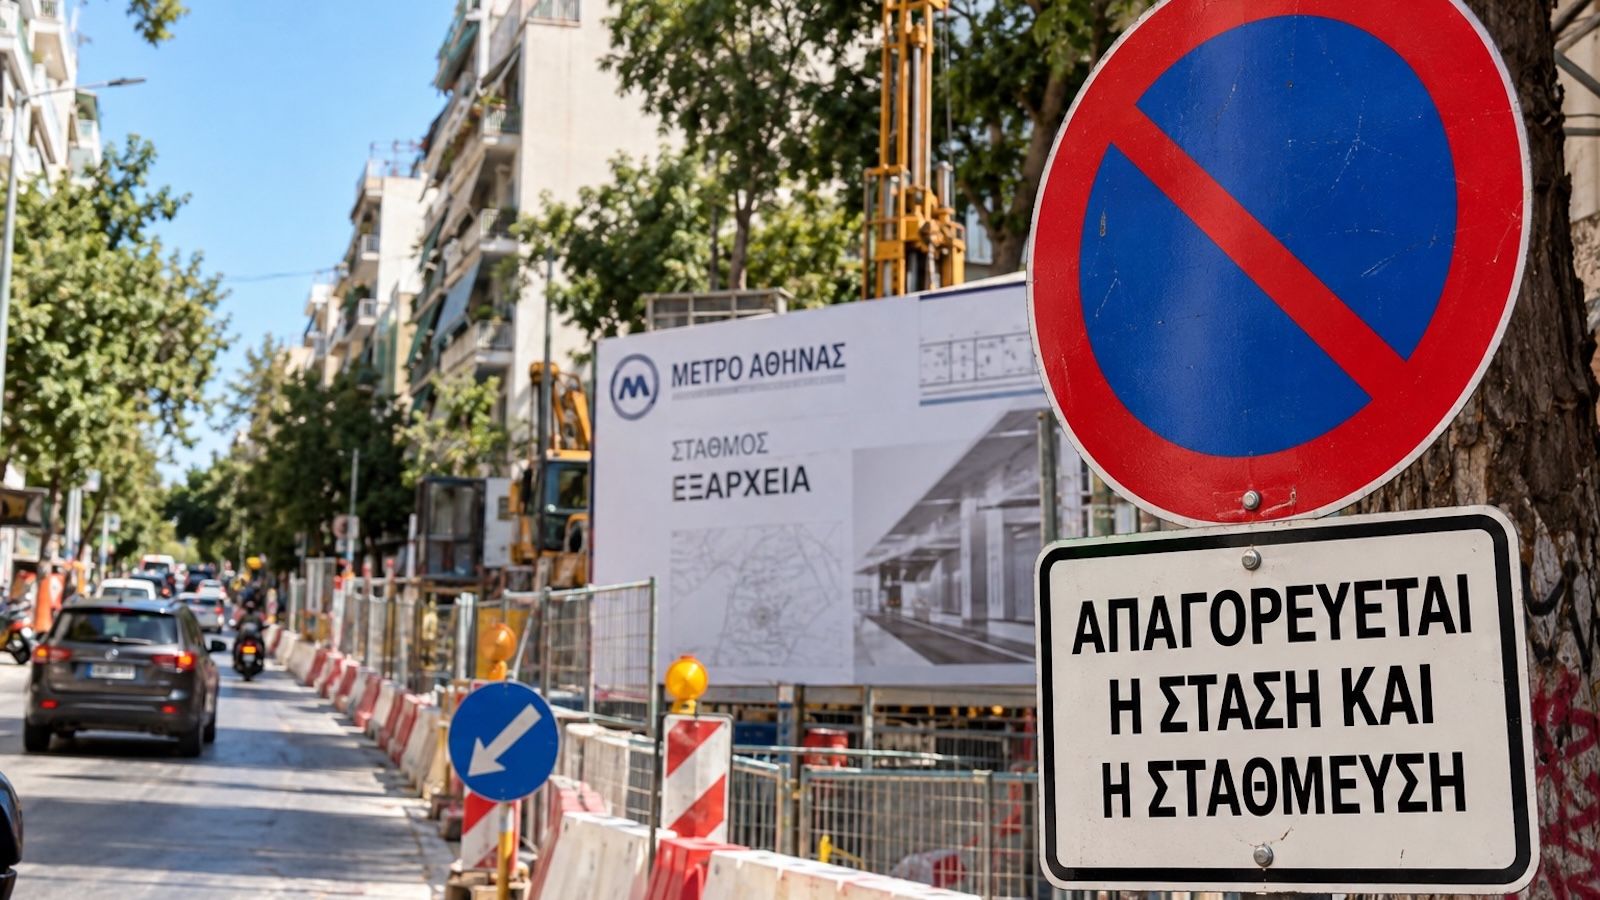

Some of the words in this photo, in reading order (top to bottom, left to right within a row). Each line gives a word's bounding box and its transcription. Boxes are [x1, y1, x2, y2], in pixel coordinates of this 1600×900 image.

[671, 355, 743, 387] ΜΕΤΡΟ
[749, 342, 846, 379] ΑΘΗΝΑΣ
[671, 431, 769, 463] ΣΤΑΘΜΟΣ
[672, 465, 811, 502] ΕΞΑΡΧΕΙΑ
[1071, 573, 1472, 655] ΑΠΑΓΟΡΕΥΕΤΑΙ
[1109, 678, 1142, 735] Η
[1159, 669, 1322, 733] ΣΤΑΣΗ
[1341, 663, 1434, 727] ΚΑΙ
[1101, 762, 1131, 819] Η
[1147, 751, 1467, 818] ΣΤΑΘΜΕΥΣΗ
